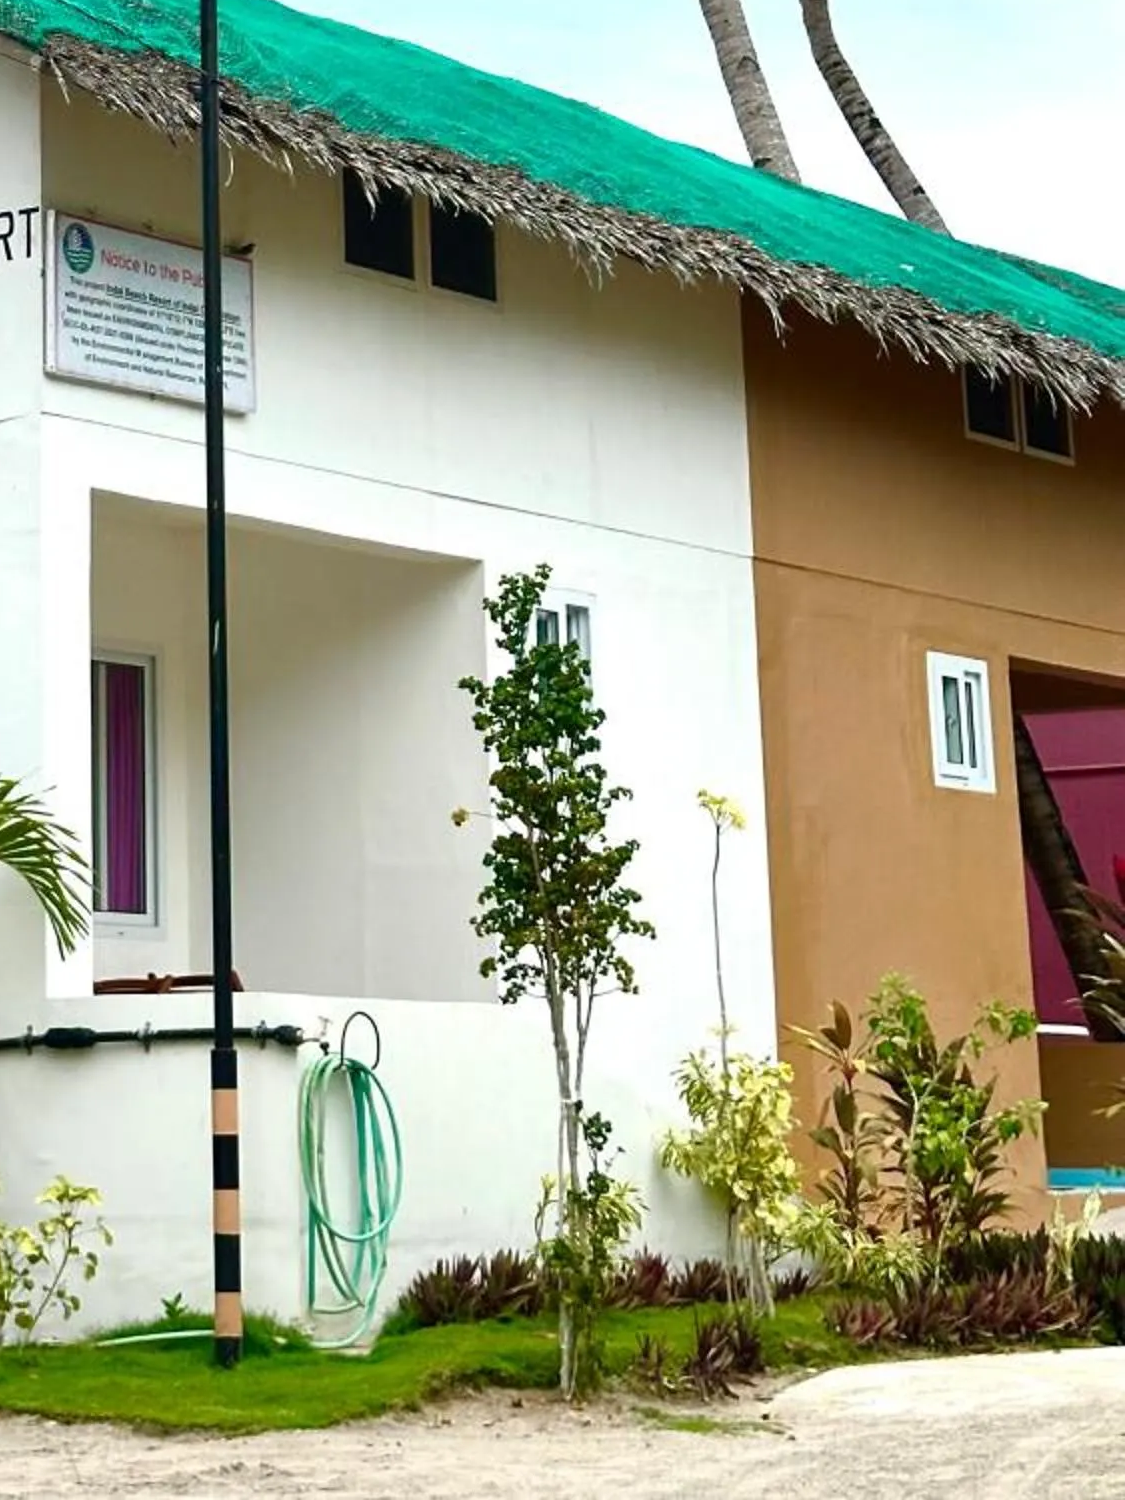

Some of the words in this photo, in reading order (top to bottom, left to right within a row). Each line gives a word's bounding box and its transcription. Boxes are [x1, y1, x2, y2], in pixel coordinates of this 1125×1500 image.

[101, 249, 140, 273] Notice
[144, 260, 156, 276] to
[160, 265, 180, 282] the
[182, 269, 204, 287] Pub
